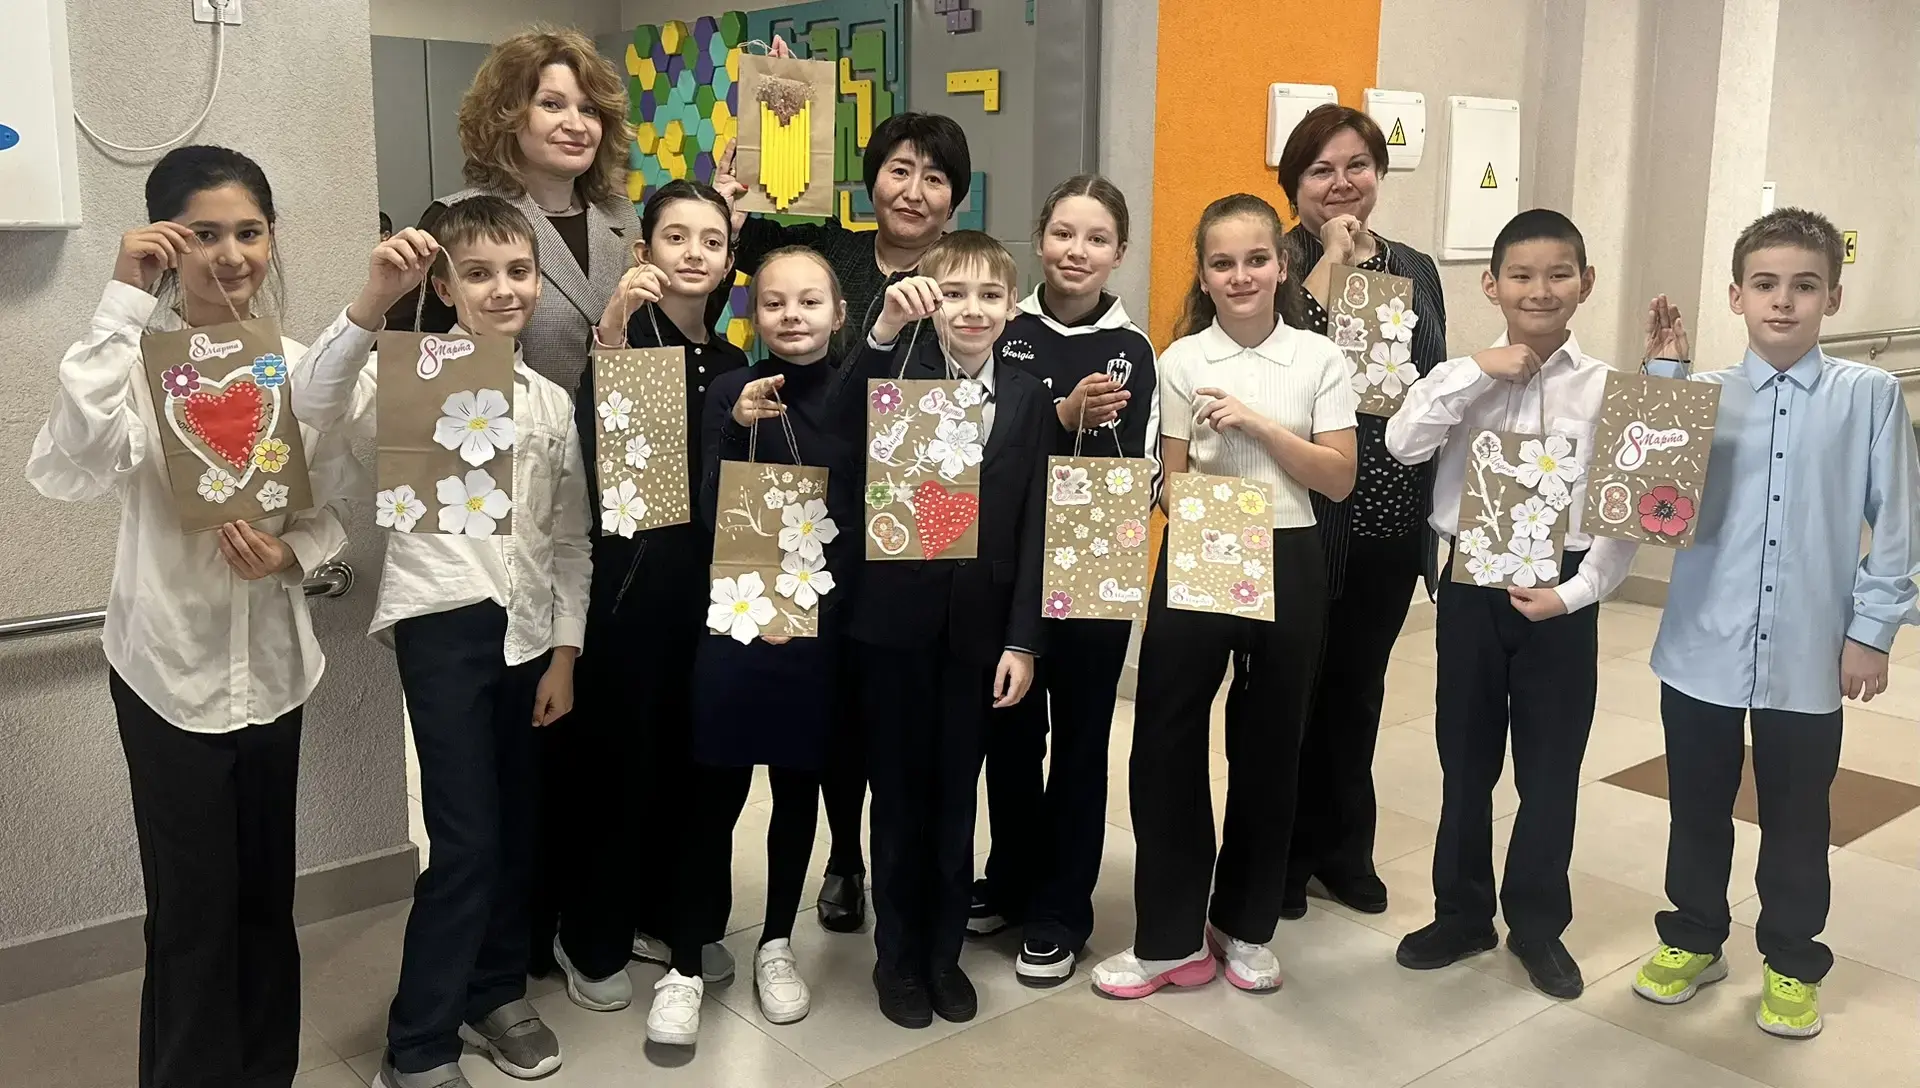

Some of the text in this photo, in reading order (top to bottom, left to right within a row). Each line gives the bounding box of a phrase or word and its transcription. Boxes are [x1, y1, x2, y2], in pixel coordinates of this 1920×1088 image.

[192, 336, 239, 358] 8 Марта
[420, 338, 472, 376] 8 Марта
[1001, 345, 1035, 361] Georgia
[1619, 425, 1684, 466] 8 Марта
